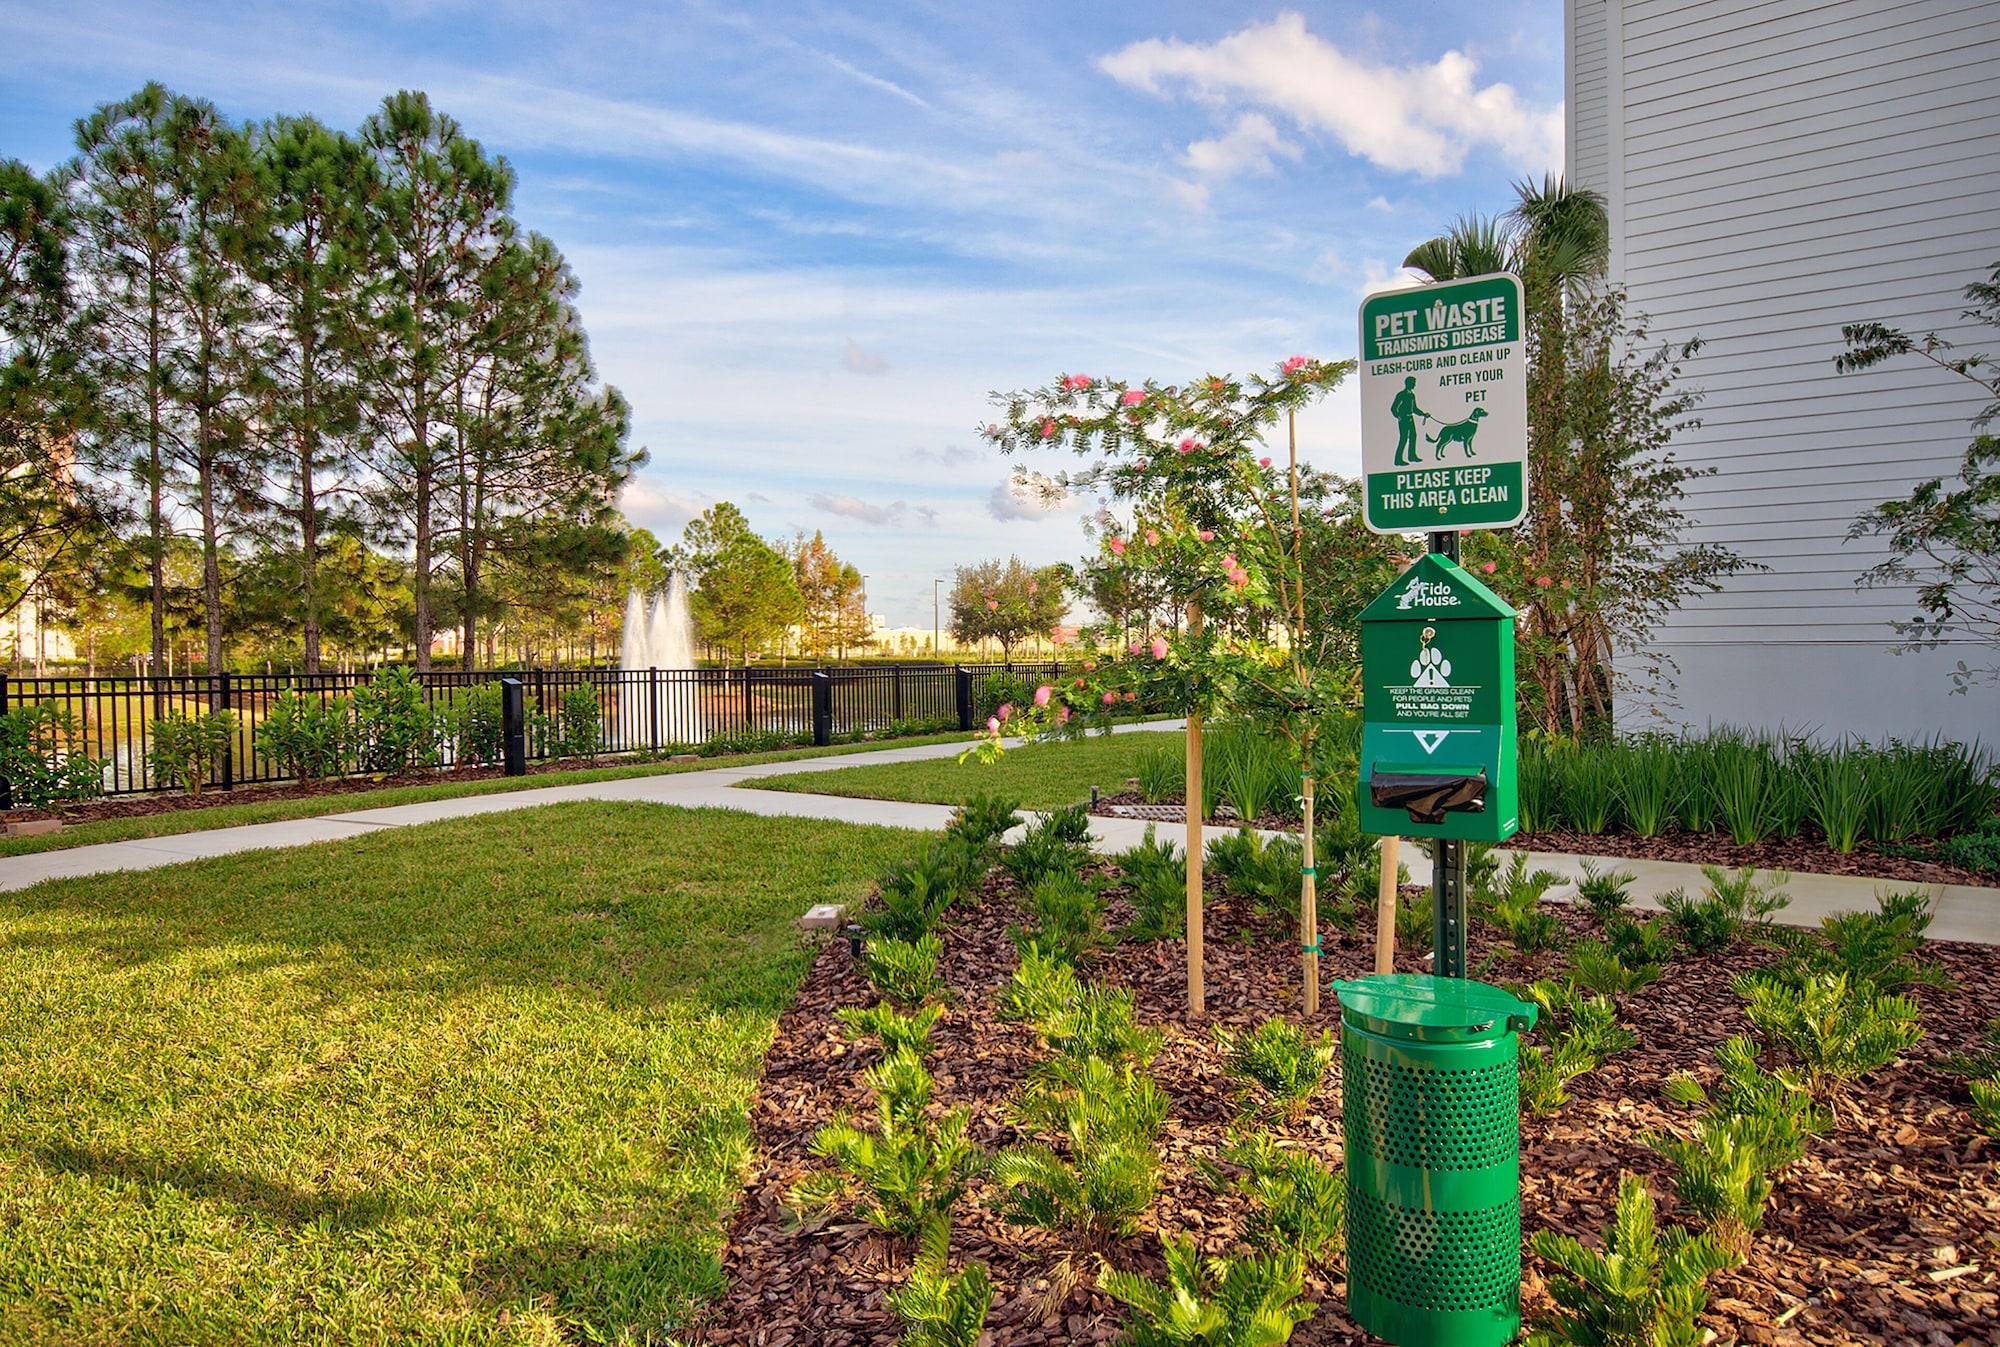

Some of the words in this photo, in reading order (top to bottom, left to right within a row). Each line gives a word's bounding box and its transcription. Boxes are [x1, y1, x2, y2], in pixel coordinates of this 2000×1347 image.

[1375, 310, 1418, 338] PET
[1425, 296, 1506, 331] WASTE
[1376, 332, 1448, 356] TRANSMITS
[1452, 325, 1506, 346] DISEASE
[1371, 358, 1433, 376] LEASH-CURB
[1436, 355, 1457, 369] AND
[1460, 351, 1493, 365] CLEAN
[1496, 348, 1511, 360] UP
[1439, 372, 1472, 387] AFTER
[1475, 368, 1504, 382] YOUR
[1465, 389, 1487, 403] PET
[1396, 471, 1450, 490] PLEASE
[1455, 467, 1491, 486] KEEP
[1381, 492, 1414, 510] THIS
[1418, 489, 1457, 507] AREA
[1460, 486, 1508, 504] CLEAN
[1419, 581, 1451, 596] Fido
